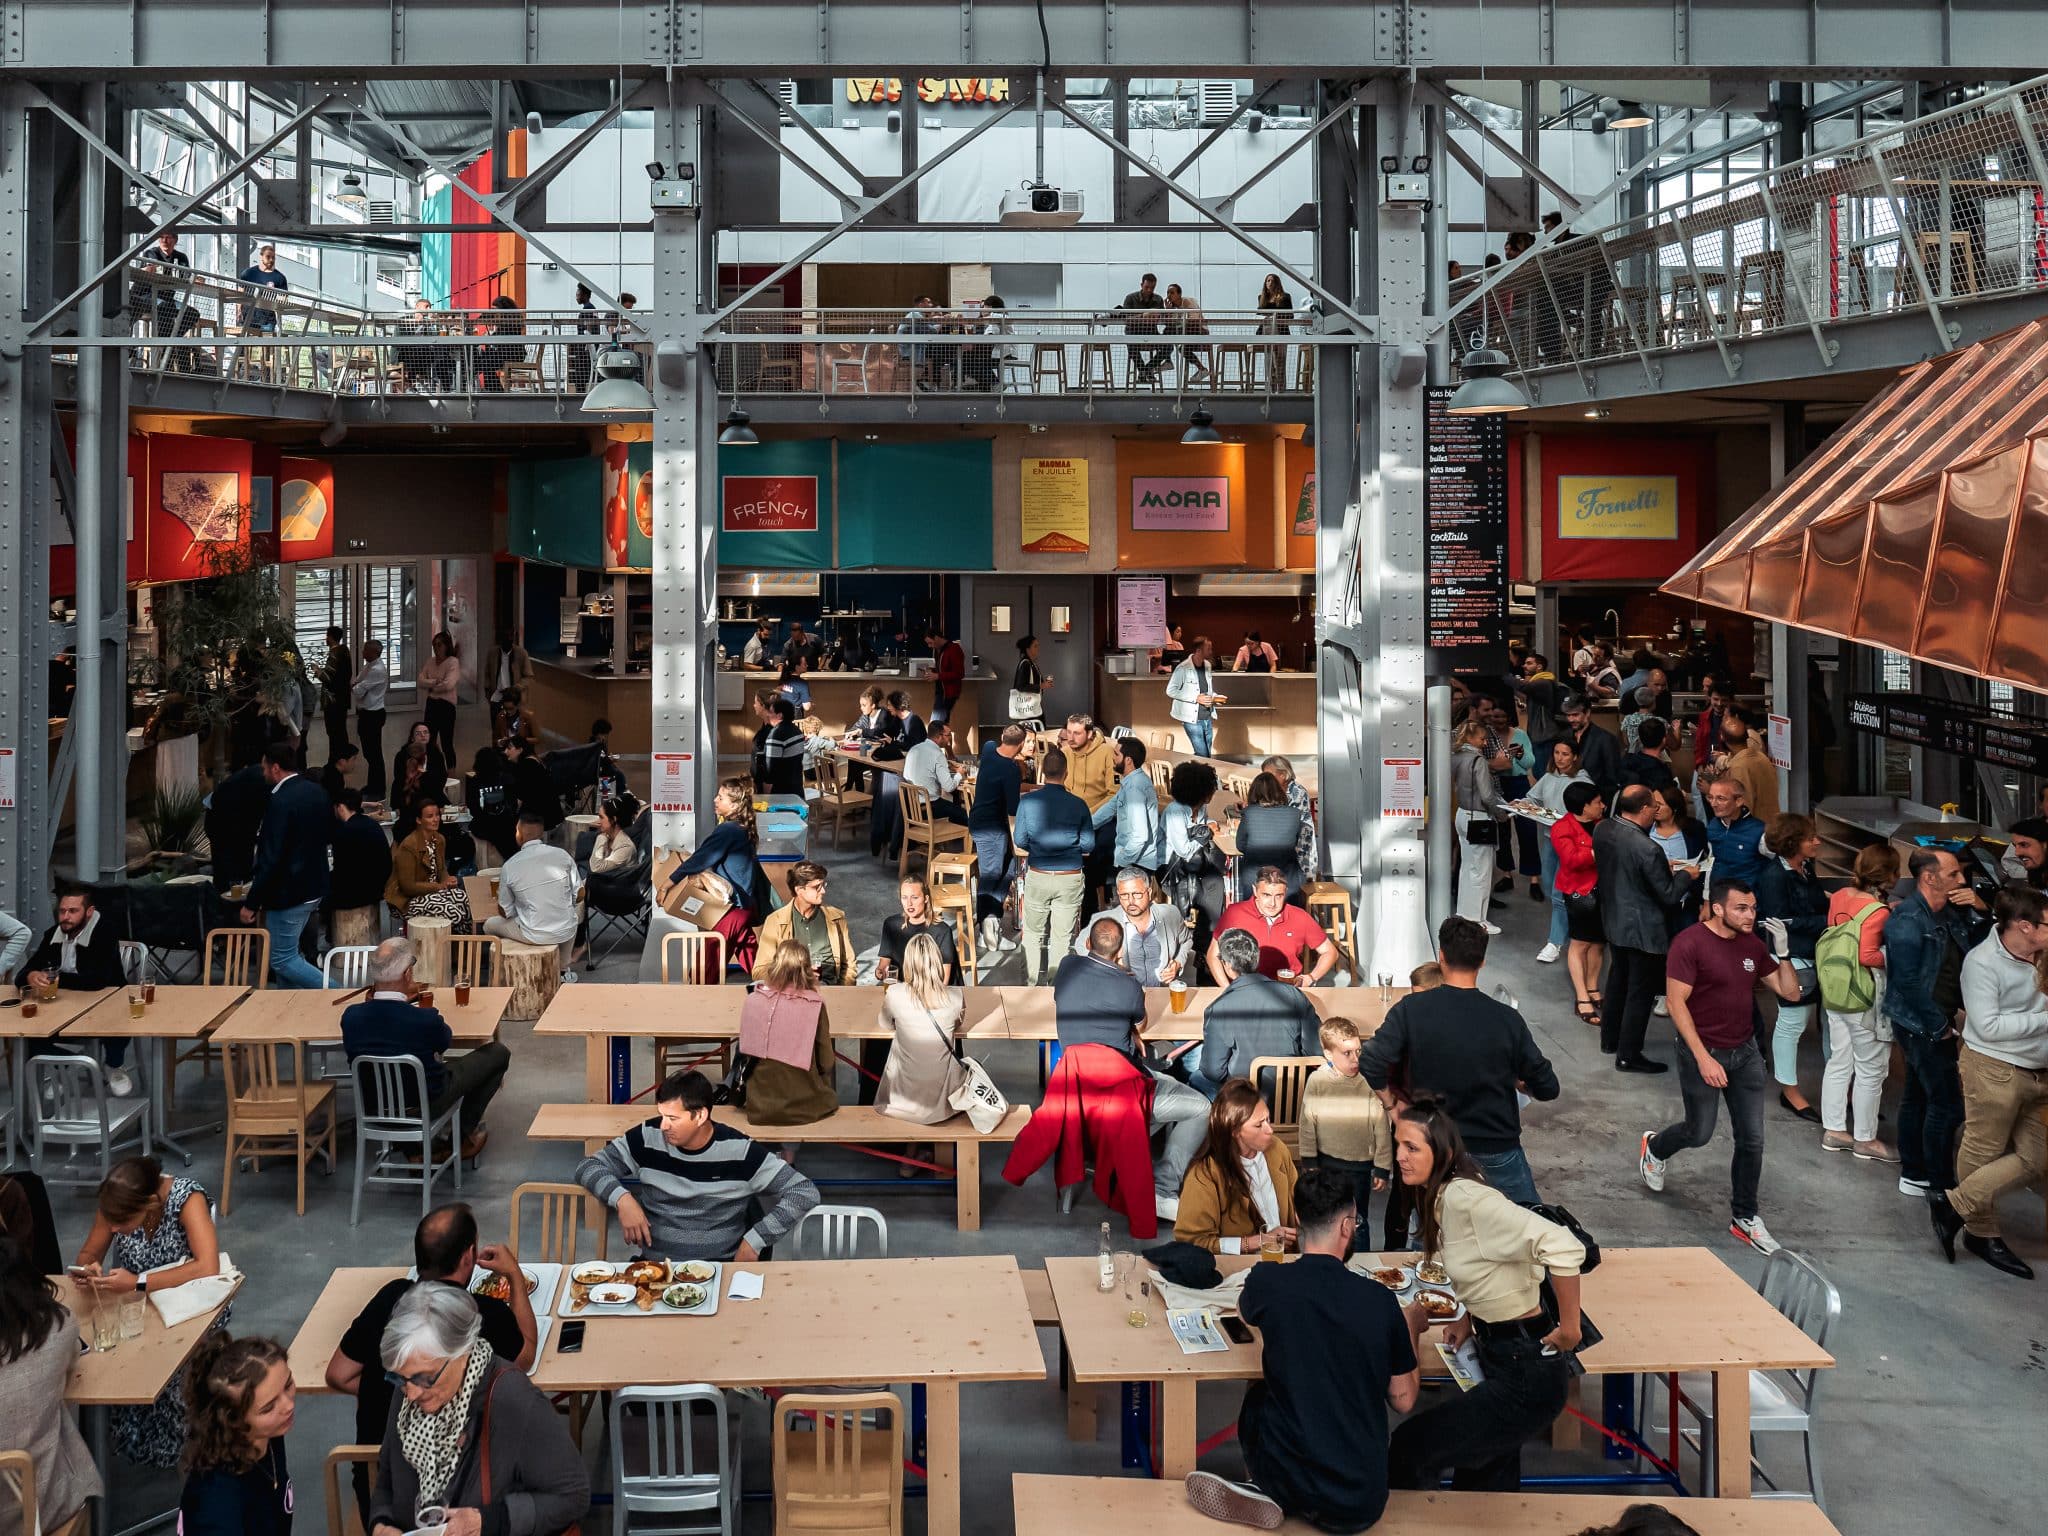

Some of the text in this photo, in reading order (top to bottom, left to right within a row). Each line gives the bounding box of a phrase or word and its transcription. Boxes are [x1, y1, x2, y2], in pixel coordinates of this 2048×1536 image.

[733, 500, 808, 520] FRENCH
[758, 516, 784, 526] touch
[1853, 712, 1881, 728] PRESSION
[653, 803, 692, 811] MAGMAA
